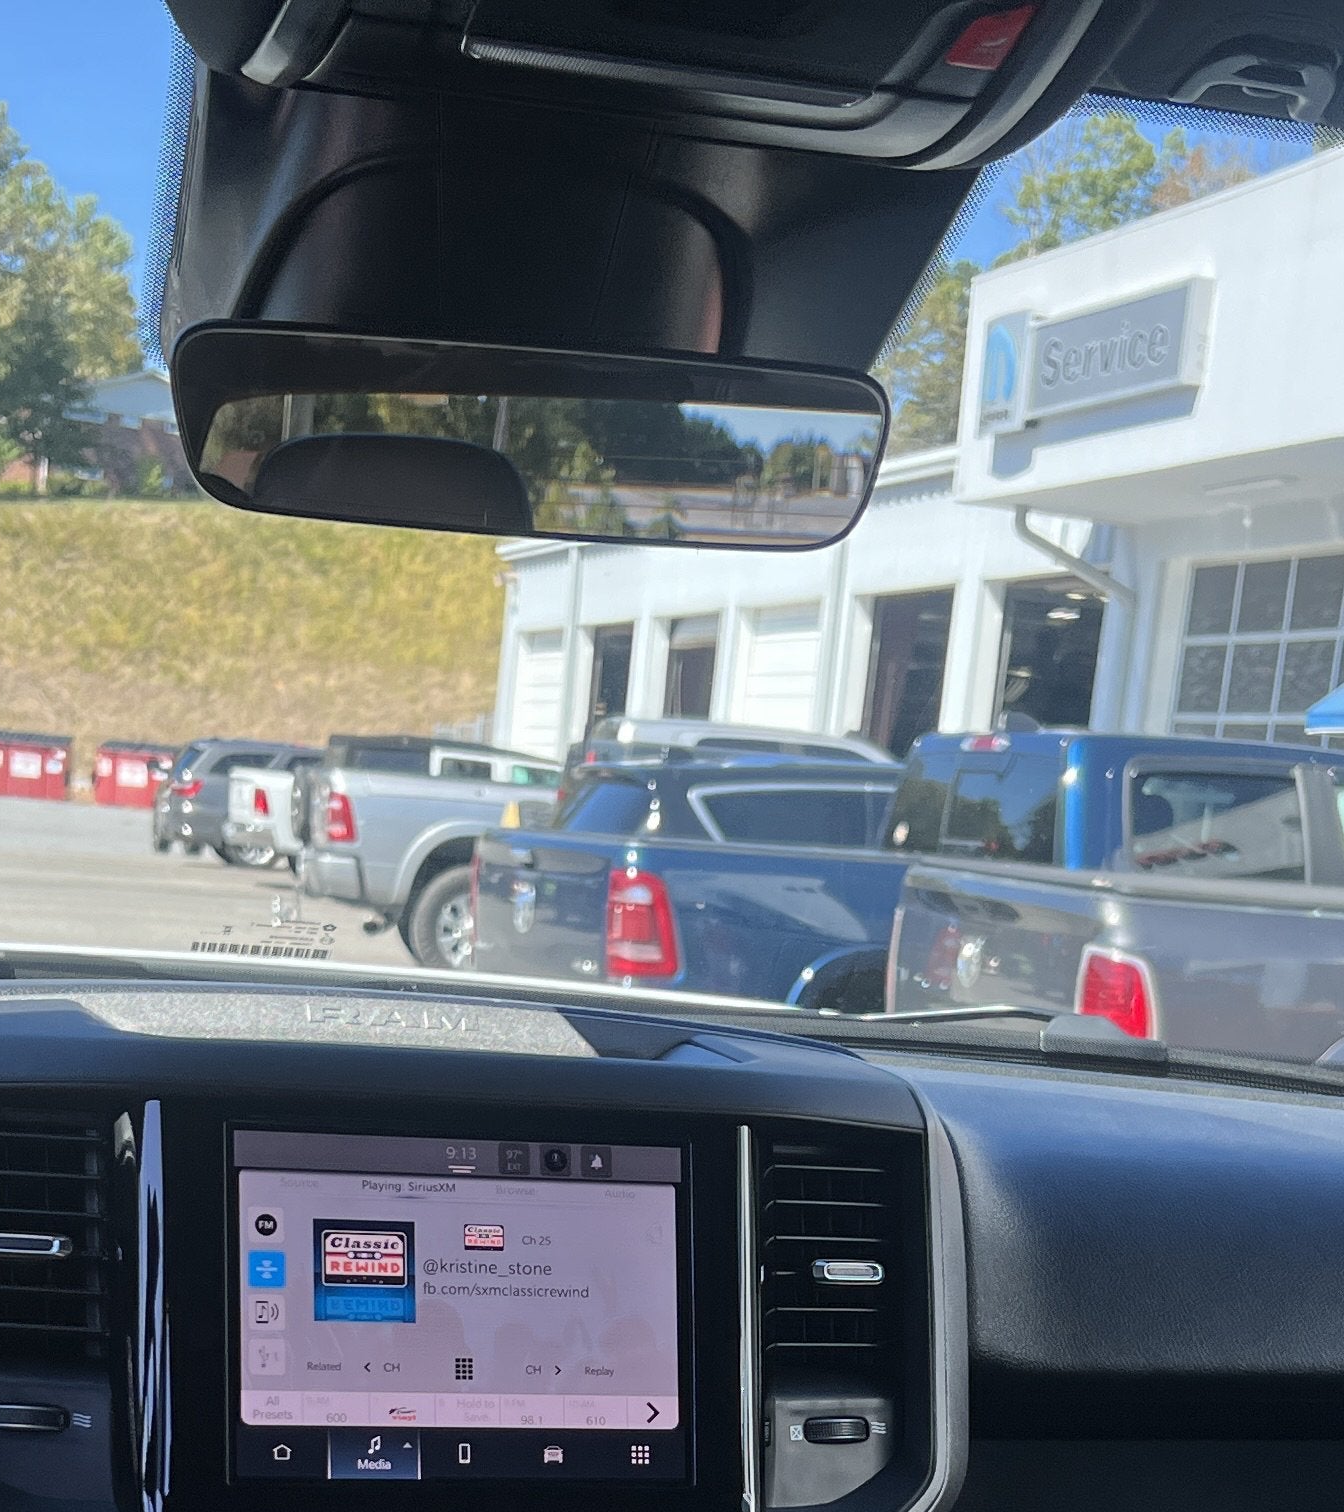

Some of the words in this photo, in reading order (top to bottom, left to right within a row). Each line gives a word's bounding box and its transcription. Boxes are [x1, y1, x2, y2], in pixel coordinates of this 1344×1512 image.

[1040, 320, 1170, 389] Service
[305, 1003, 480, 1032] RAM
[445, 1146, 477, 1160] 9:13
[408, 1180, 457, 1193] SiriusXM
[257, 1220, 275, 1230] FM
[330, 1236, 400, 1250] Classic
[521, 1235, 537, 1246] Ch
[538, 1235, 552, 1246] 25
[330, 1260, 401, 1274] REWIND
[422, 1257, 553, 1278] @kristine_stone
[423, 1281, 590, 1299] fb.com/sxmclassicrewind
[306, 1361, 342, 1372] Related
[383, 1362, 401, 1373] CH
[525, 1365, 542, 1376] CH
[584, 1366, 614, 1378] Replay
[265, 1396, 280, 1406] All
[252, 1409, 294, 1421] Presets
[326, 1413, 348, 1424] 600
[520, 1415, 543, 1426] 98.1
[586, 1415, 606, 1426] 610
[357, 1458, 392, 1471] Media
